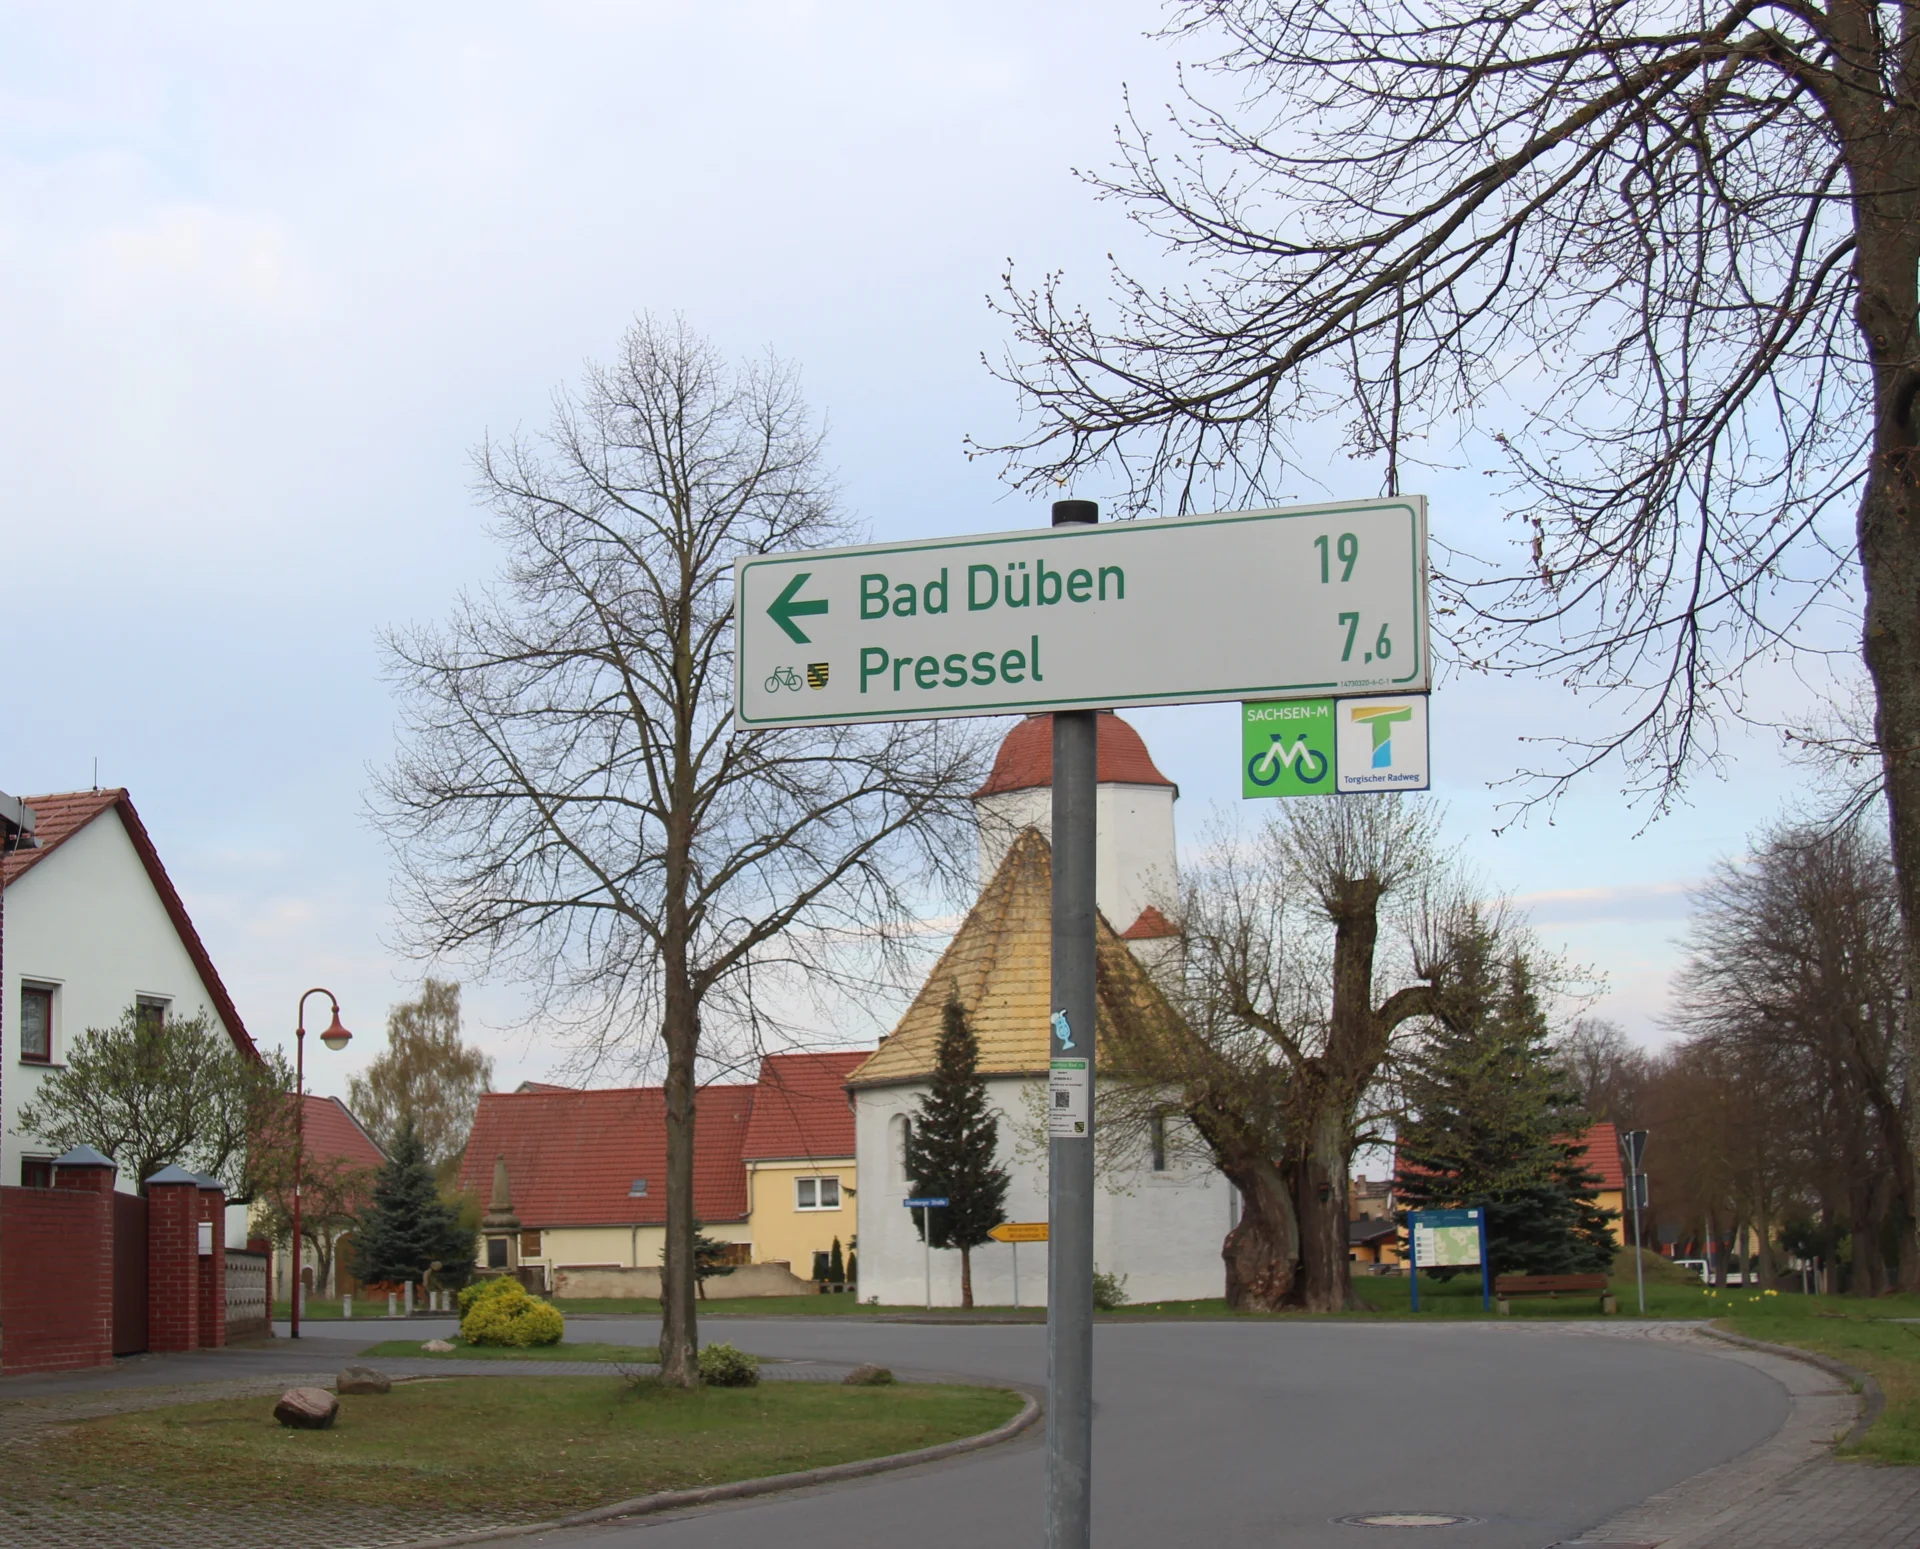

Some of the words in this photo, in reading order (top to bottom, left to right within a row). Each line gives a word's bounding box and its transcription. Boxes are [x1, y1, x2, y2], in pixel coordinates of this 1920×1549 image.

[1313, 532, 1359, 584] 19
[860, 567, 948, 620] Bad
[967, 558, 1125, 611] Düben
[860, 634, 1043, 693] Pressel
[1338, 611, 1392, 665] 7,6
[1248, 706, 1328, 722] SACHSEN-M
[1344, 775, 1386, 785] Torgischer
[1387, 773, 1420, 783] Radweg
